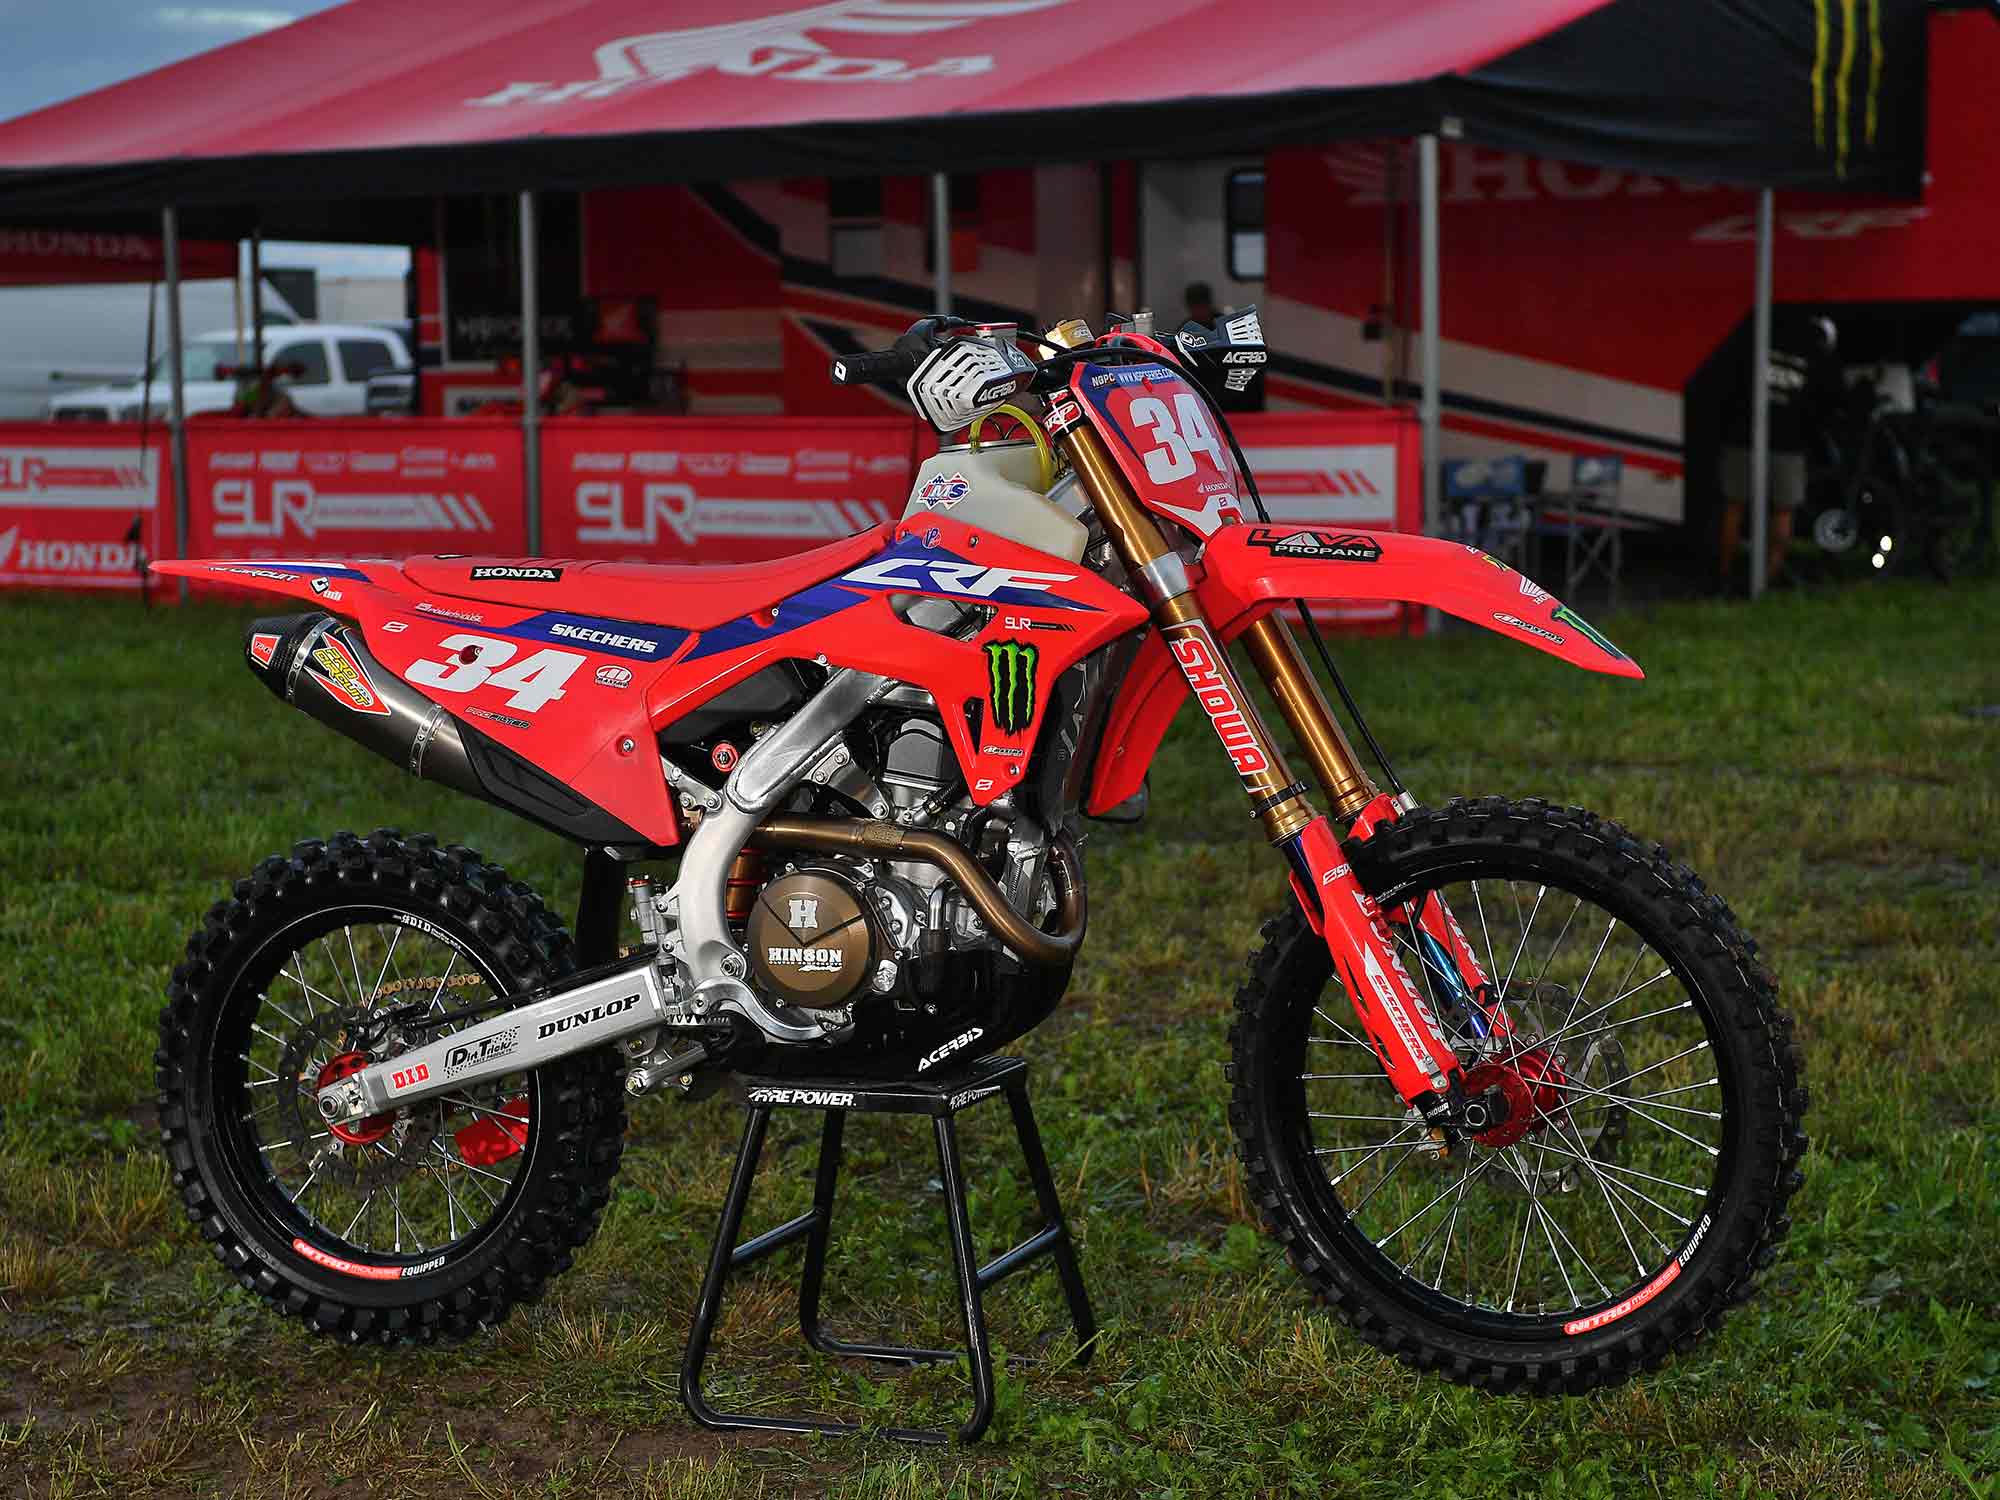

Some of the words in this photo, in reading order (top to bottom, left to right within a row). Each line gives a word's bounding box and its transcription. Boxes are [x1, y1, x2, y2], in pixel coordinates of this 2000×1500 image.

[1091, 372, 1115, 387] NGPC
[1129, 393, 1229, 485] 34
[922, 482, 967, 499] IMS
[1248, 529, 1377, 549] LAVA
[1274, 544, 1377, 558] PROPANE
[474, 567, 556, 579] HONDA
[840, 557, 1079, 598] CRF
[549, 622, 659, 654] SKECHERS
[1004, 616, 1032, 631] SLR
[315, 650, 371, 707] CIRCUIT
[327, 648, 359, 681] PRO
[403, 633, 587, 713] 34
[1168, 636, 1271, 777] SHOWA
[788, 899, 818, 929] H
[768, 947, 843, 963] HINSON
[537, 993, 641, 1040] DUNLOP
[1678, 1213, 1712, 1267] EQUIPPED
[401, 1255, 446, 1277] EQUIPPED
